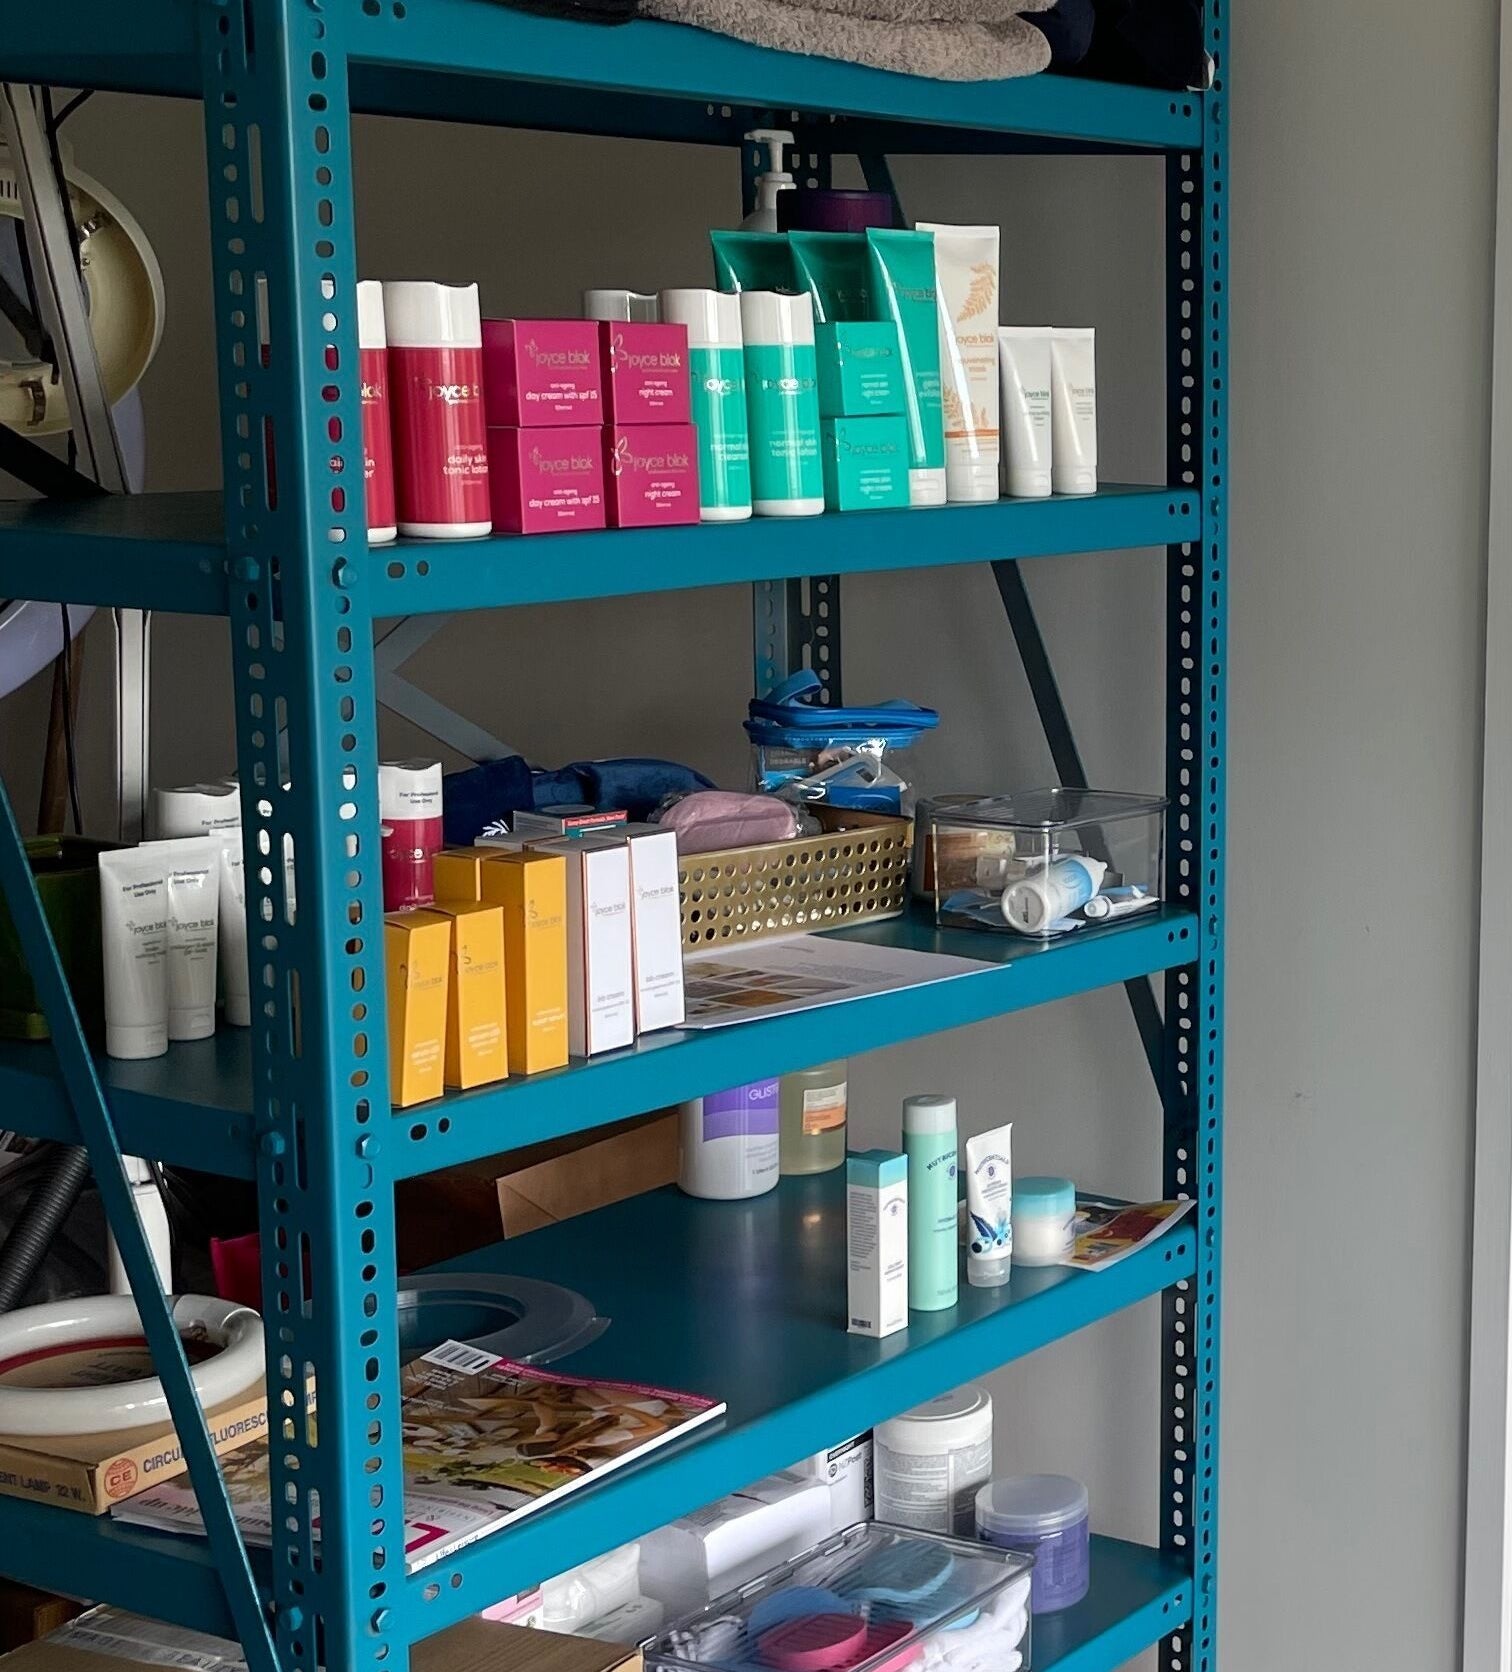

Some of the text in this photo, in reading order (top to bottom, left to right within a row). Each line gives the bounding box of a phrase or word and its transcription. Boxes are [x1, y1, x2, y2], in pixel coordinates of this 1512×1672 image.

[535, 349, 591, 367] joyce blok
[628, 352, 681, 369] joyce blok
[525, 391, 540, 402] day
[541, 391, 563, 400] cream
[443, 465, 470, 475] tonic
[539, 456, 594, 475] joyce blok
[633, 453, 689, 473] joyce blok
[529, 499, 543, 509] day
[543, 498, 566, 507] cream
[110, 1469, 132, 1487] CE
